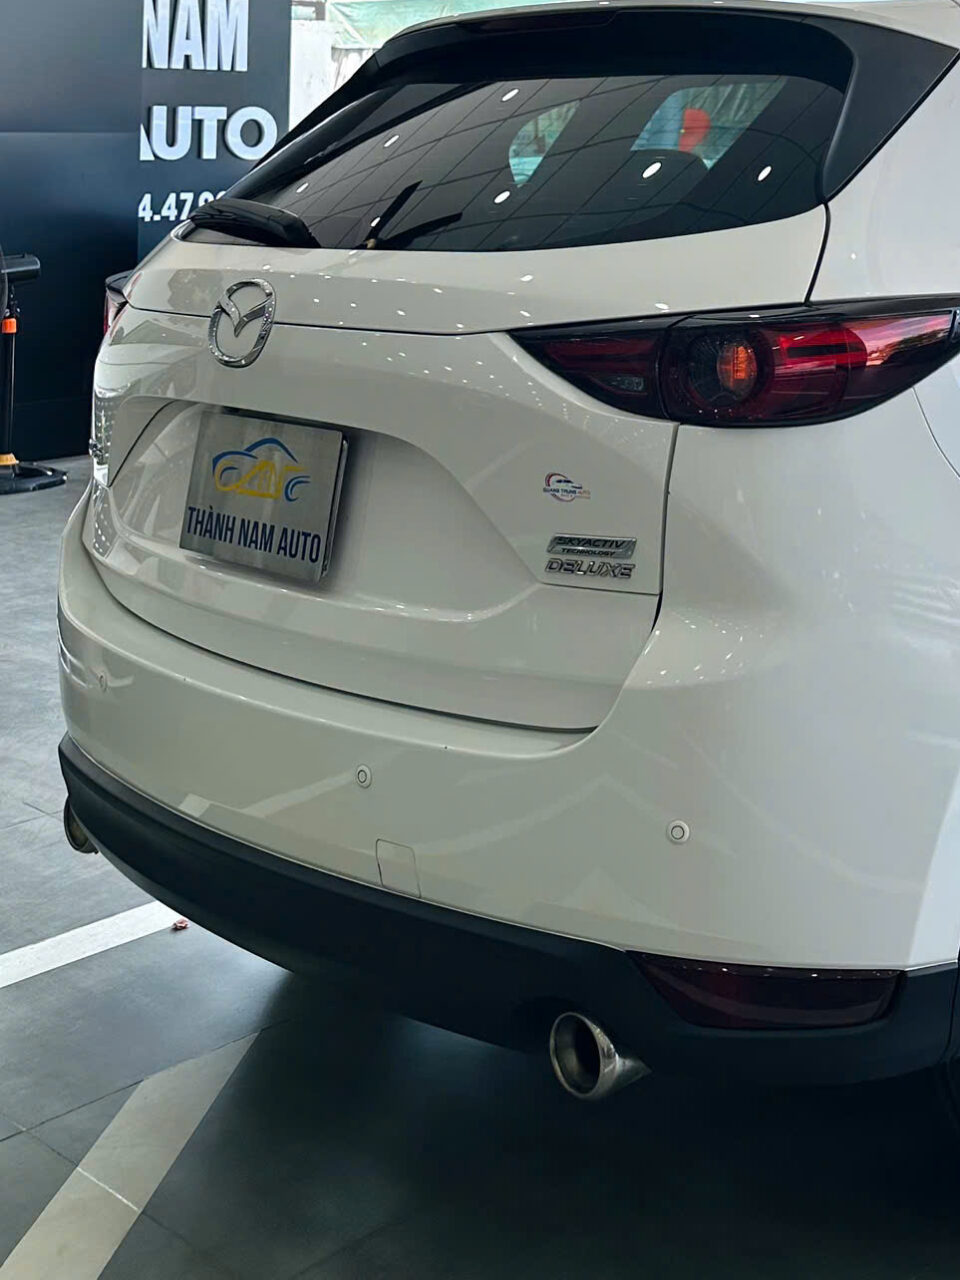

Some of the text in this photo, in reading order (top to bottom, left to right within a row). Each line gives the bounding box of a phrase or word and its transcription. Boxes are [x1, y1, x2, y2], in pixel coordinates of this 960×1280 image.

[138, 190, 227, 222] 4.47
[187, 504, 321, 563] THÀNH NAM AUTO
[555, 536, 626, 549] SKYACTIV
[561, 547, 616, 557] TECHNOLOGY
[545, 558, 636, 579] DELUXE
